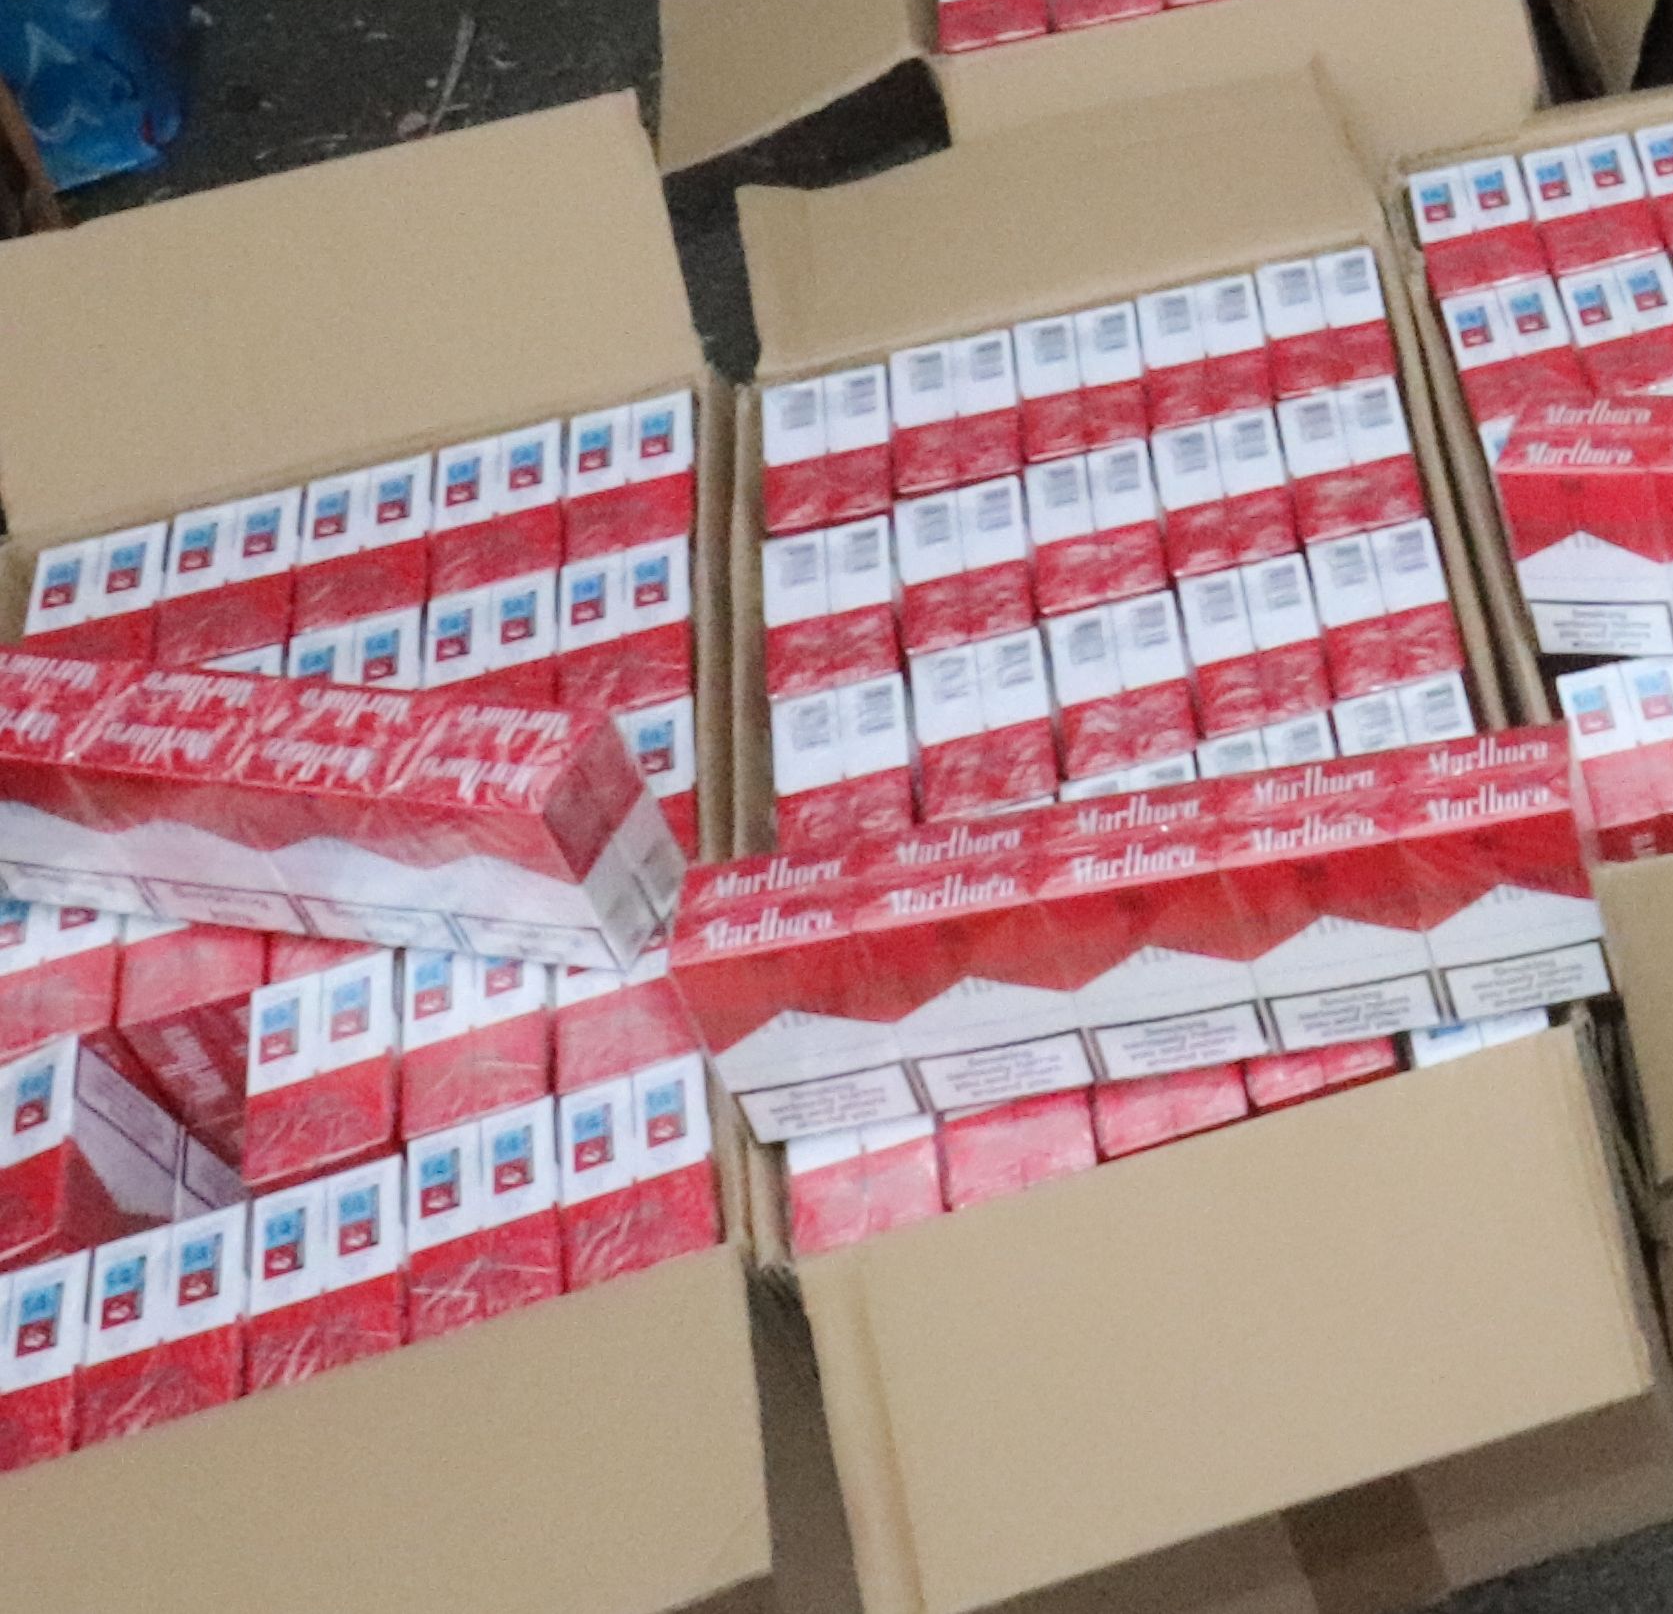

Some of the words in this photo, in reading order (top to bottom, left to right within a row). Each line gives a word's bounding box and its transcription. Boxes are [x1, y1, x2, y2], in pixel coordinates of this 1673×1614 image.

[1526, 438, 1634, 466] Marlboro
[1545, 399, 1652, 425] Marlboro
[716, 858, 842, 898] Marlboro
[897, 826, 1022, 866] Marlboro
[1078, 794, 1200, 835] Marlboro
[1253, 766, 1375, 805] Marlboro
[1428, 737, 1549, 776] Marlboro
[705, 907, 833, 950] Marlboro
[889, 874, 1016, 915] Marlboro
[1073, 843, 1197, 883] Marlboro
[1251, 815, 1375, 852] Marlboro
[1426, 784, 1549, 821] Marlboro
